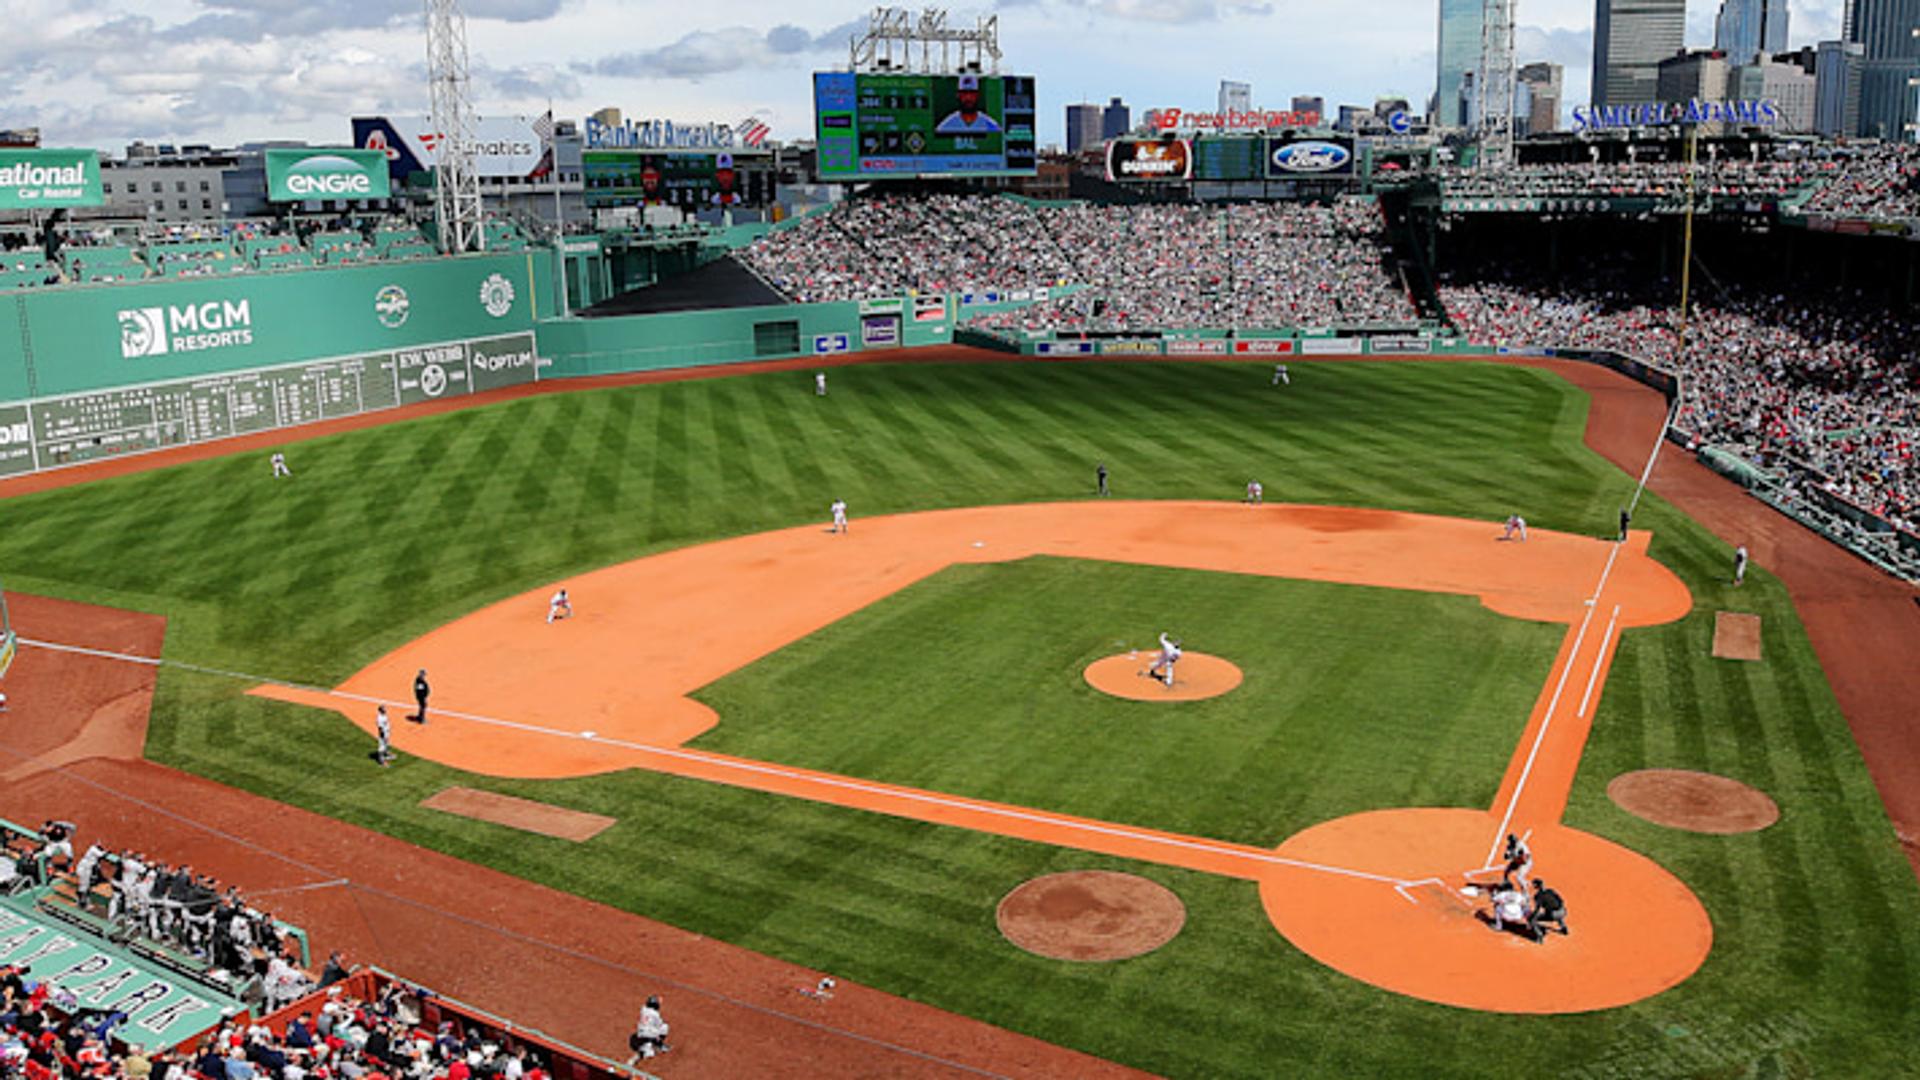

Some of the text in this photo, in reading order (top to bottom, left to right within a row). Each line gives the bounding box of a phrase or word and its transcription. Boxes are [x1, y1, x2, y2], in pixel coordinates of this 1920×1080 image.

[1183, 110, 1228, 128] new
[1229, 106, 1320, 128] balance
[1572, 97, 1778, 133] SAMUEL ADAMS
[586, 116, 638, 148] Bank
[664, 118, 734, 148] America
[1287, 149, 1335, 168] Ford
[168, 299, 250, 333] MGM
[172, 330, 253, 352] RESORTS
[488, 351, 532, 372] OPTUM
[49, 952, 212, 1035] PARK
